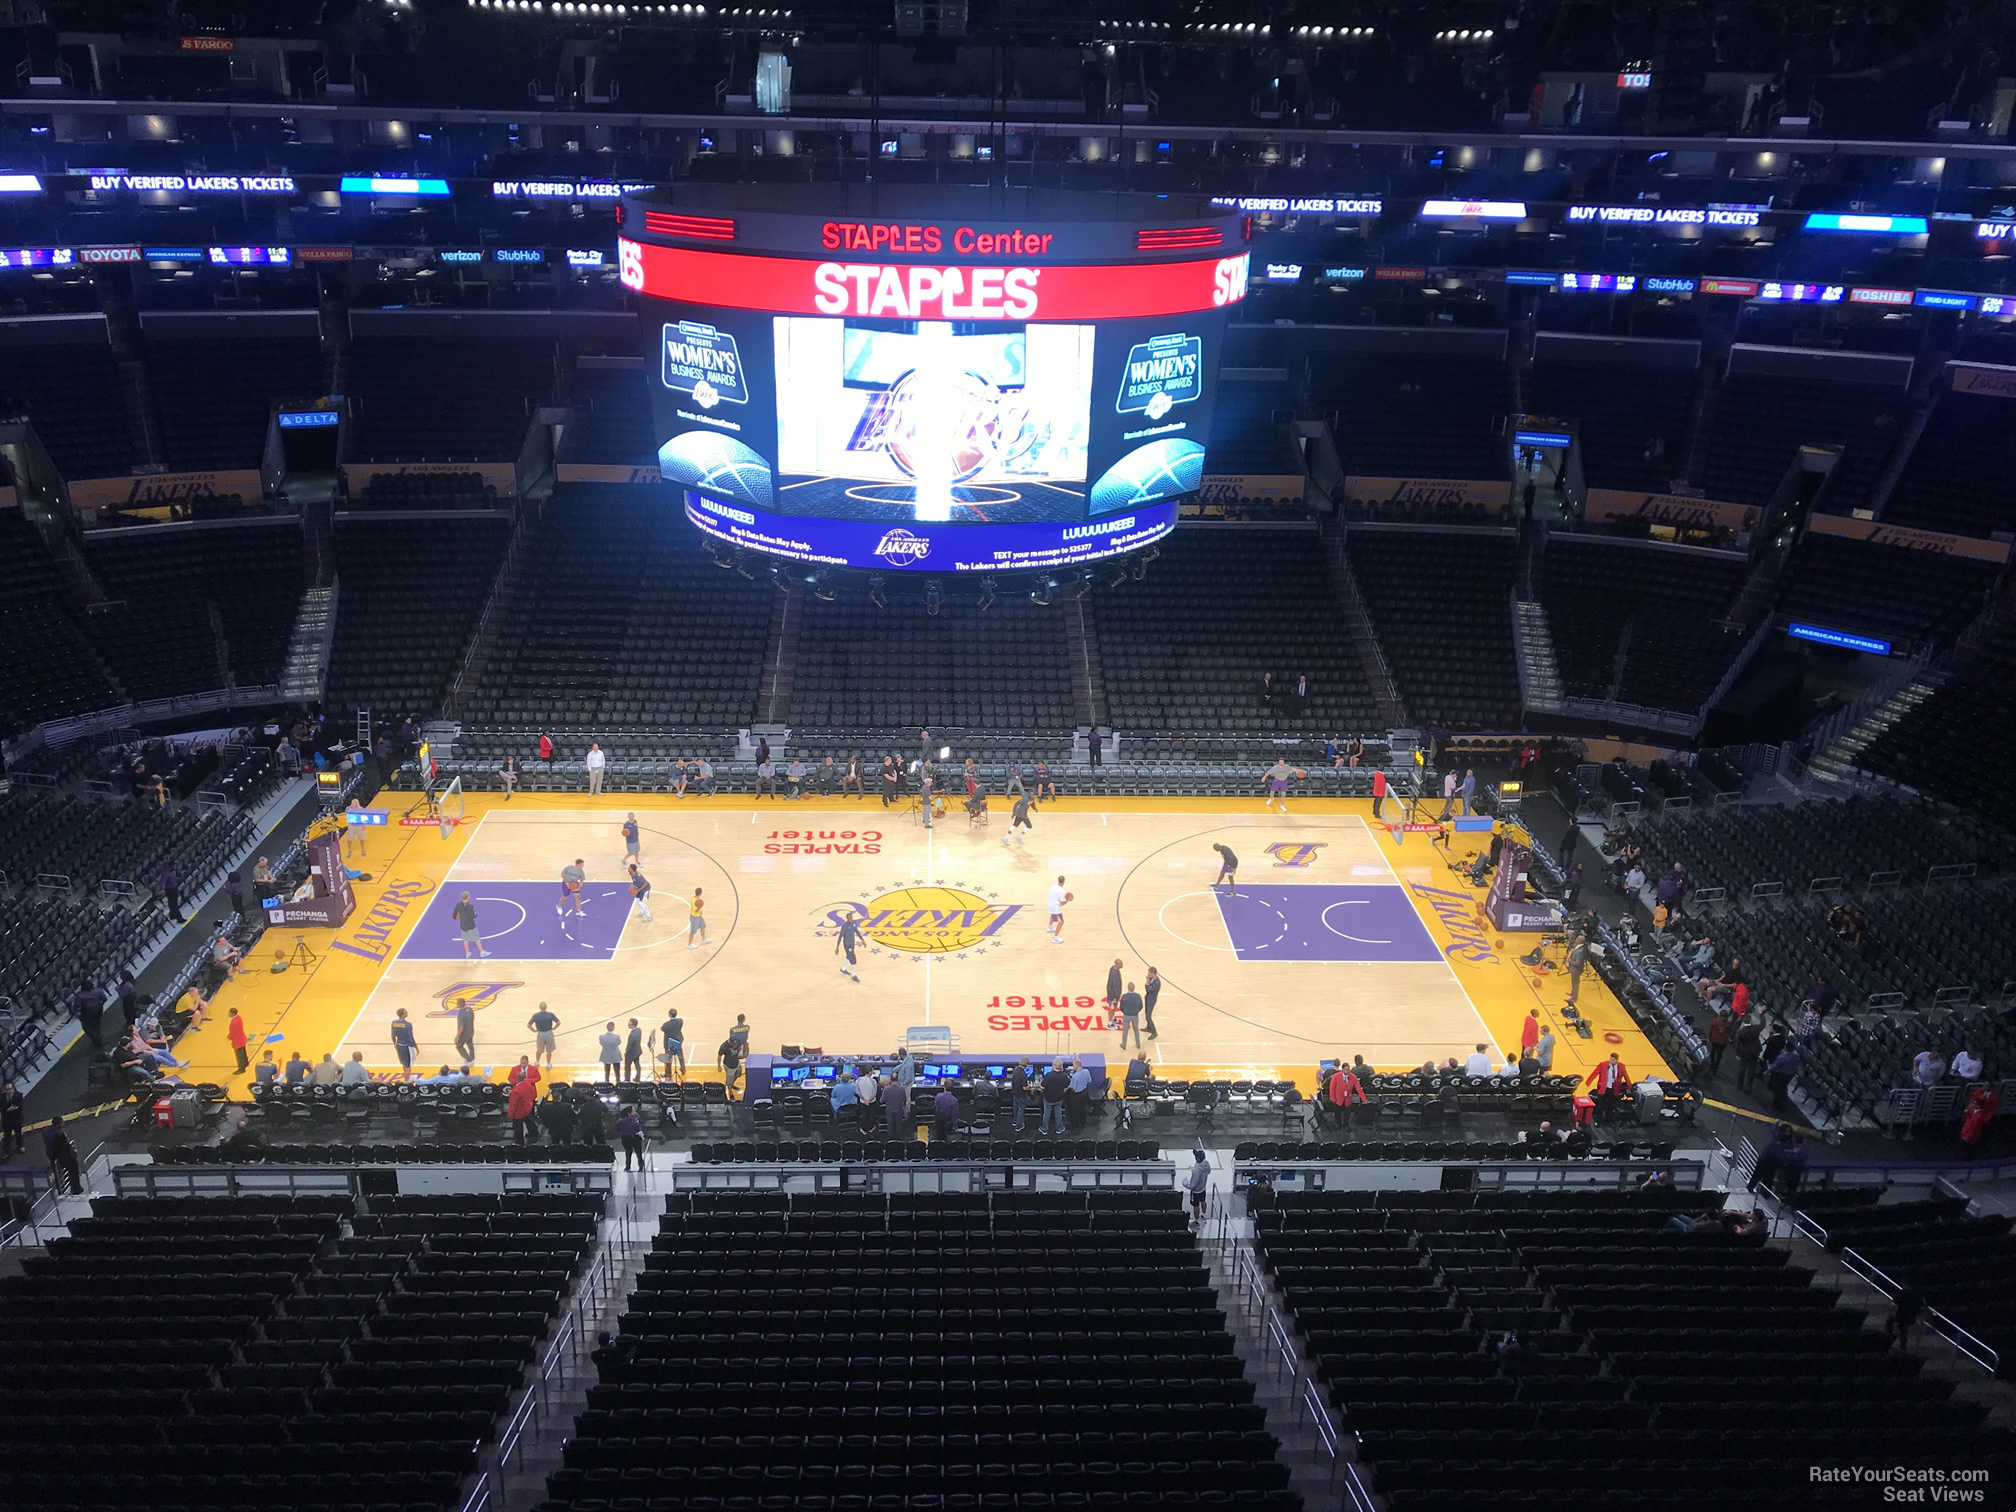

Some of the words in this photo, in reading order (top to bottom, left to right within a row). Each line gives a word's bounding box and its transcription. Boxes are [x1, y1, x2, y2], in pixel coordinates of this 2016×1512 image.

[92, 177, 120, 189] BUY
[124, 177, 184, 190] VERIFIED
[188, 177, 239, 191] LAKERS
[241, 177, 294, 191] TICKETS
[494, 182, 519, 194] BUY
[521, 183, 574, 195] VERIFIED
[576, 184, 621, 196] LAKERS
[1238, 198, 1288, 211] VERIFIED
[1290, 199, 1333, 212] LAKERS
[1336, 200, 1382, 213] TICKETS
[1570, 207, 1598, 219] BUY
[1600, 208, 1653, 222] VERIFIED
[1656, 209, 1705, 223] LAKERS
[1706, 211, 1760, 225] TICKETS
[822, 222, 942, 252] STAPLES
[953, 227, 1053, 254] Center
[1978, 223, 2011, 238] BUY
[81, 249, 141, 261] TOYOTA
[441, 251, 481, 261] verizon
[497, 250, 540, 262] StubHub
[1326, 267, 1364, 278] verizon
[814, 262, 1038, 319] STAPLES
[1648, 278, 1694, 291] StubHub
[1809, 285, 1816, 293] 2
[1854, 290, 1911, 303] TOSHIBA
[1924, 296, 1941, 304] BUD
[1942, 297, 1967, 306] LIGHT
[686, 336, 713, 348] PRESENTS
[667, 341, 736, 374] WOMEN'S
[1152, 348, 1179, 359] PRESENTS
[670, 363, 704, 381] BUSINESS
[706, 370, 736, 387] AWARDS
[1130, 354, 1197, 384] WOMEN'S
[1128, 381, 1163, 397] BUSINESS
[1164, 376, 1193, 391] AWARDS
[295, 414, 337, 424] DELTA
[1392, 480, 1468, 506] LAKERS
[759, 533, 776, 544] Rates
[777, 537, 790, 548] May
[790, 540, 813, 551] Apply.
[873, 536, 932, 559] LAKERS
[736, 537, 744, 545] No
[744, 540, 770, 552] purchase
[769, 546, 800, 559] necessary
[800, 551, 809, 560] to
[809, 553, 848, 565] participate
[993, 551, 1012, 560] TEXT
[1012, 552, 1029, 560] your
[1030, 549, 1060, 558] message
[955, 562, 969, 570] The
[971, 561, 995, 570] Lakers
[996, 560, 1010, 569] will
[1010, 560, 1039, 568] confirm
[1039, 557, 1064, 566] receipt
[1071, 555, 1086, 564] your
[1086, 549, 1103, 560] initial
[1794, 627, 1842, 642] AMERICAN
[1843, 638, 1885, 651] EXPRESS
[767, 831, 882, 841] Center
[764, 843, 881, 854] STAPLES
[329, 875, 436, 968] LAKERS
[811, 901, 1034, 936] LAKERS
[1407, 879, 1500, 969] LAKERS
[987, 995, 1122, 1010] Center
